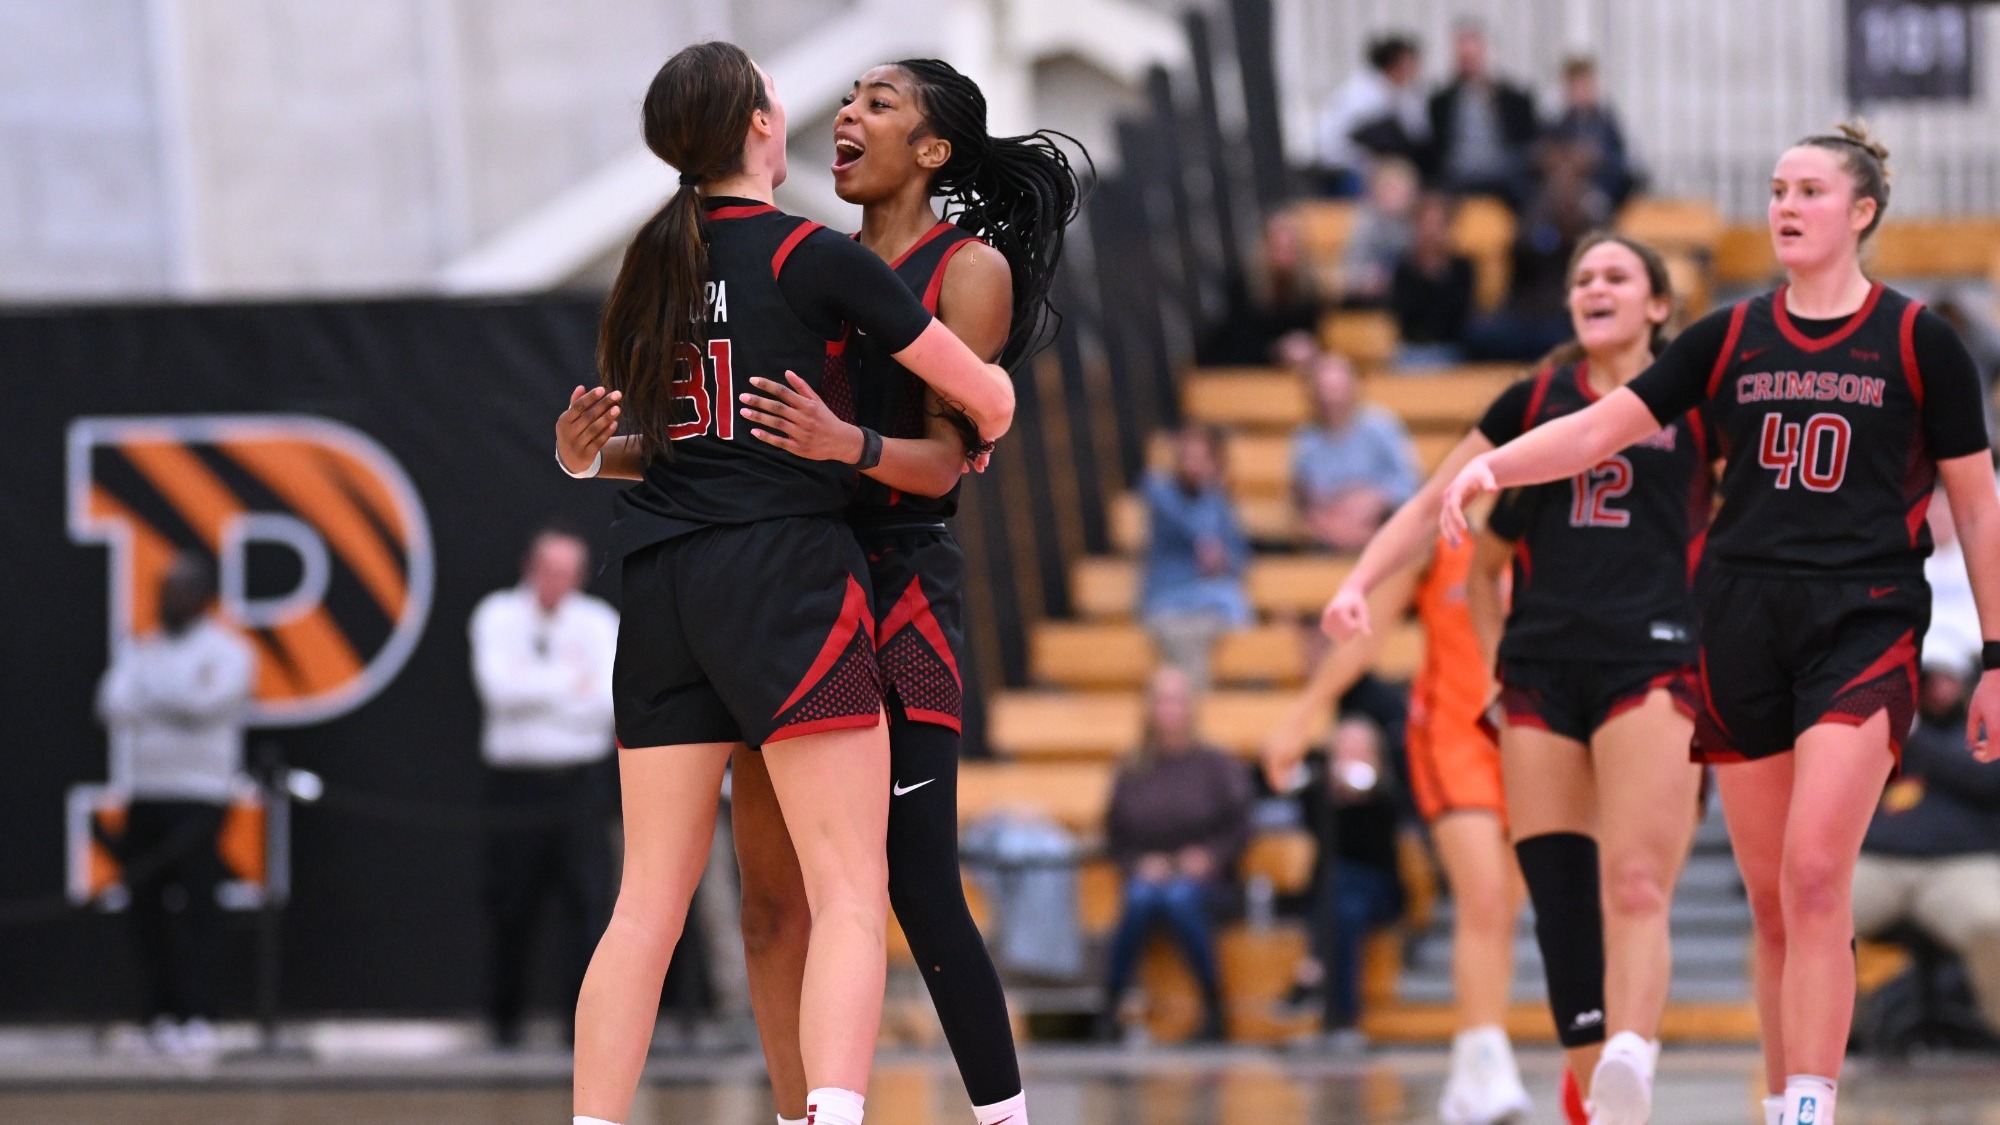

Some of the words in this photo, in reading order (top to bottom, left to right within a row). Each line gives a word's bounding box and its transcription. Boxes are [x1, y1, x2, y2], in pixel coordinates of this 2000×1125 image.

[667, 339, 734, 440] 31
[1736, 371, 1886, 407] CRIMSON
[1758, 412, 1851, 492] 40
[1569, 454, 1634, 528] 12
